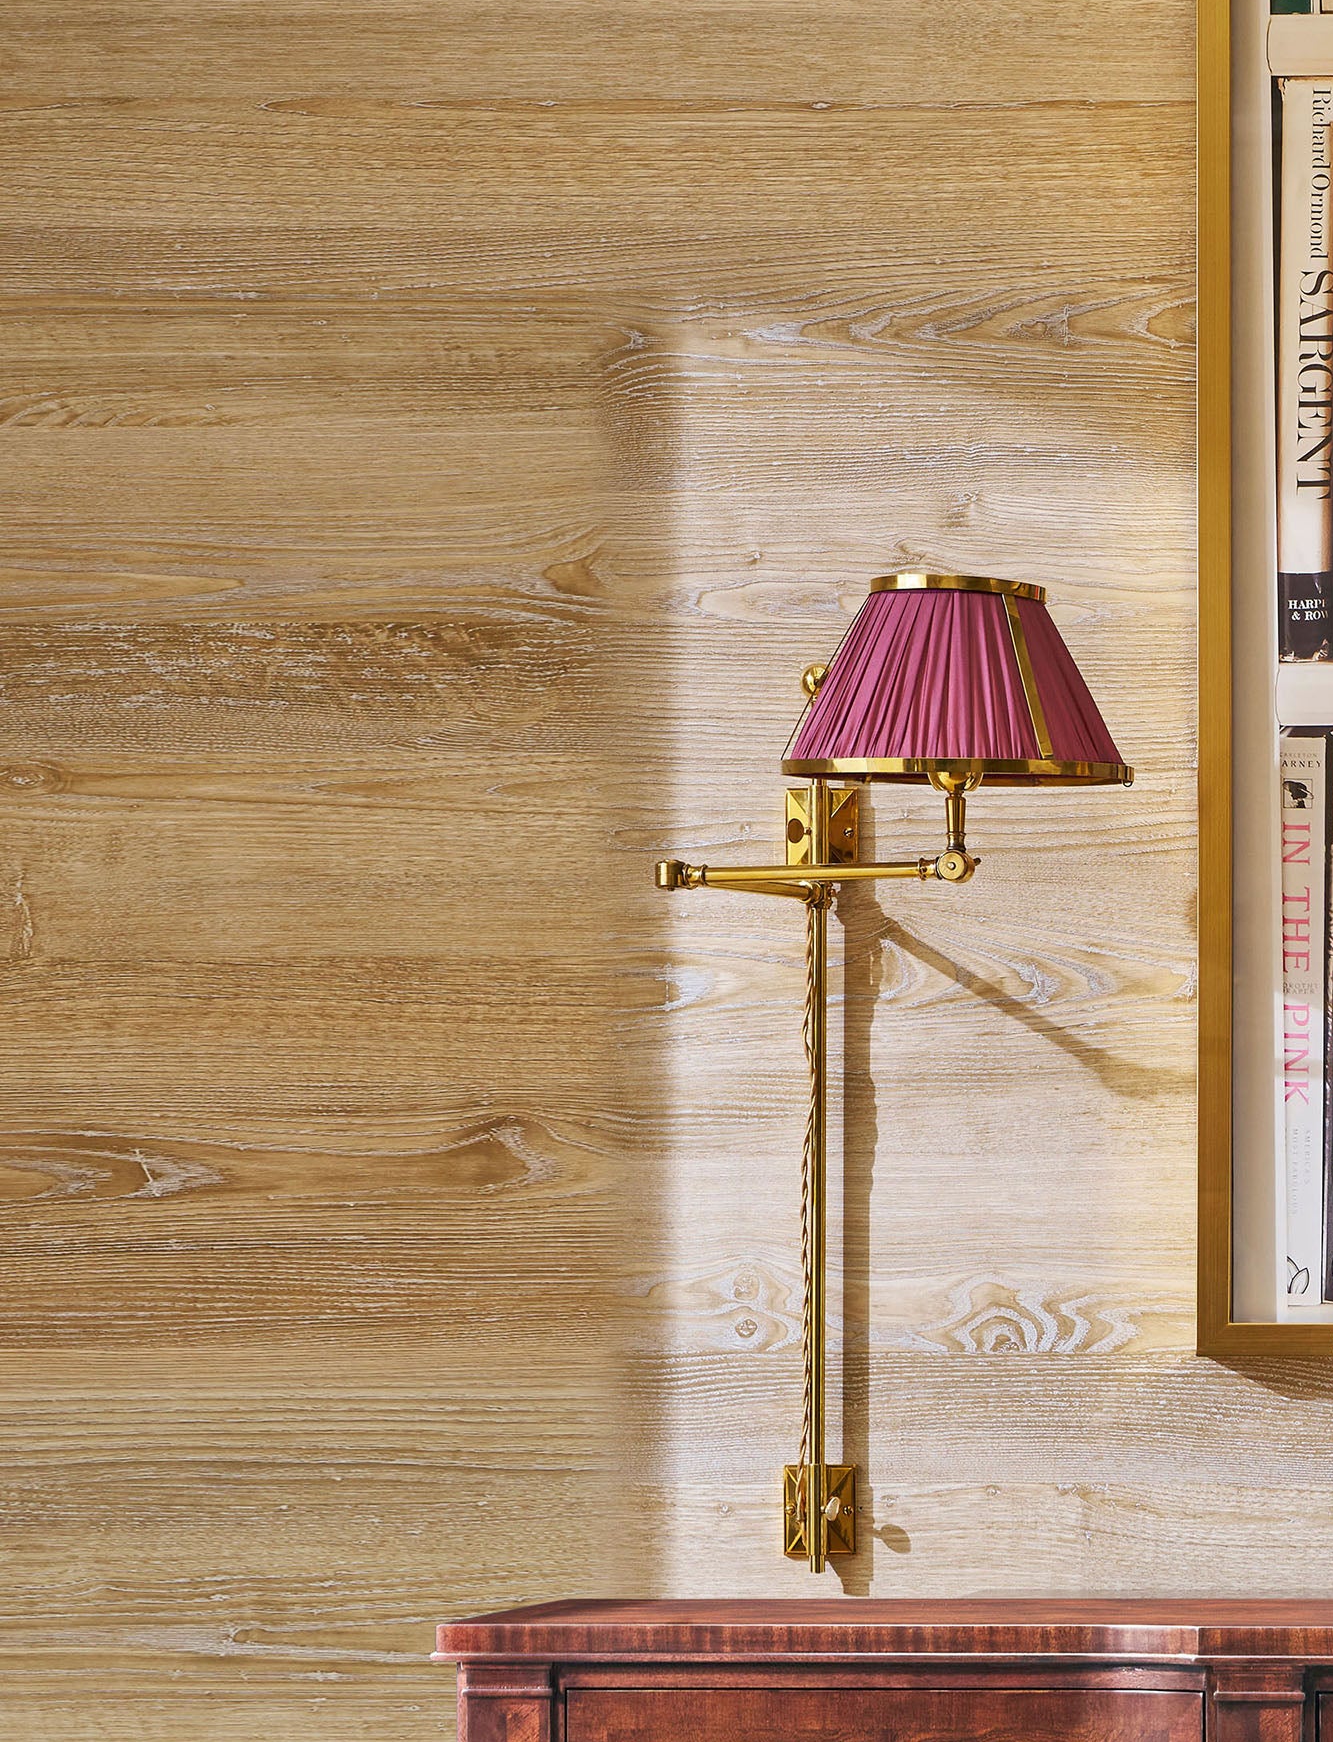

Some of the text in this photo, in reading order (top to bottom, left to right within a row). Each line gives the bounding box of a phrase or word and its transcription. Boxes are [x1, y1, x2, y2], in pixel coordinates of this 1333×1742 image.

[1281, 823, 1312, 1103] IN THE PINK
